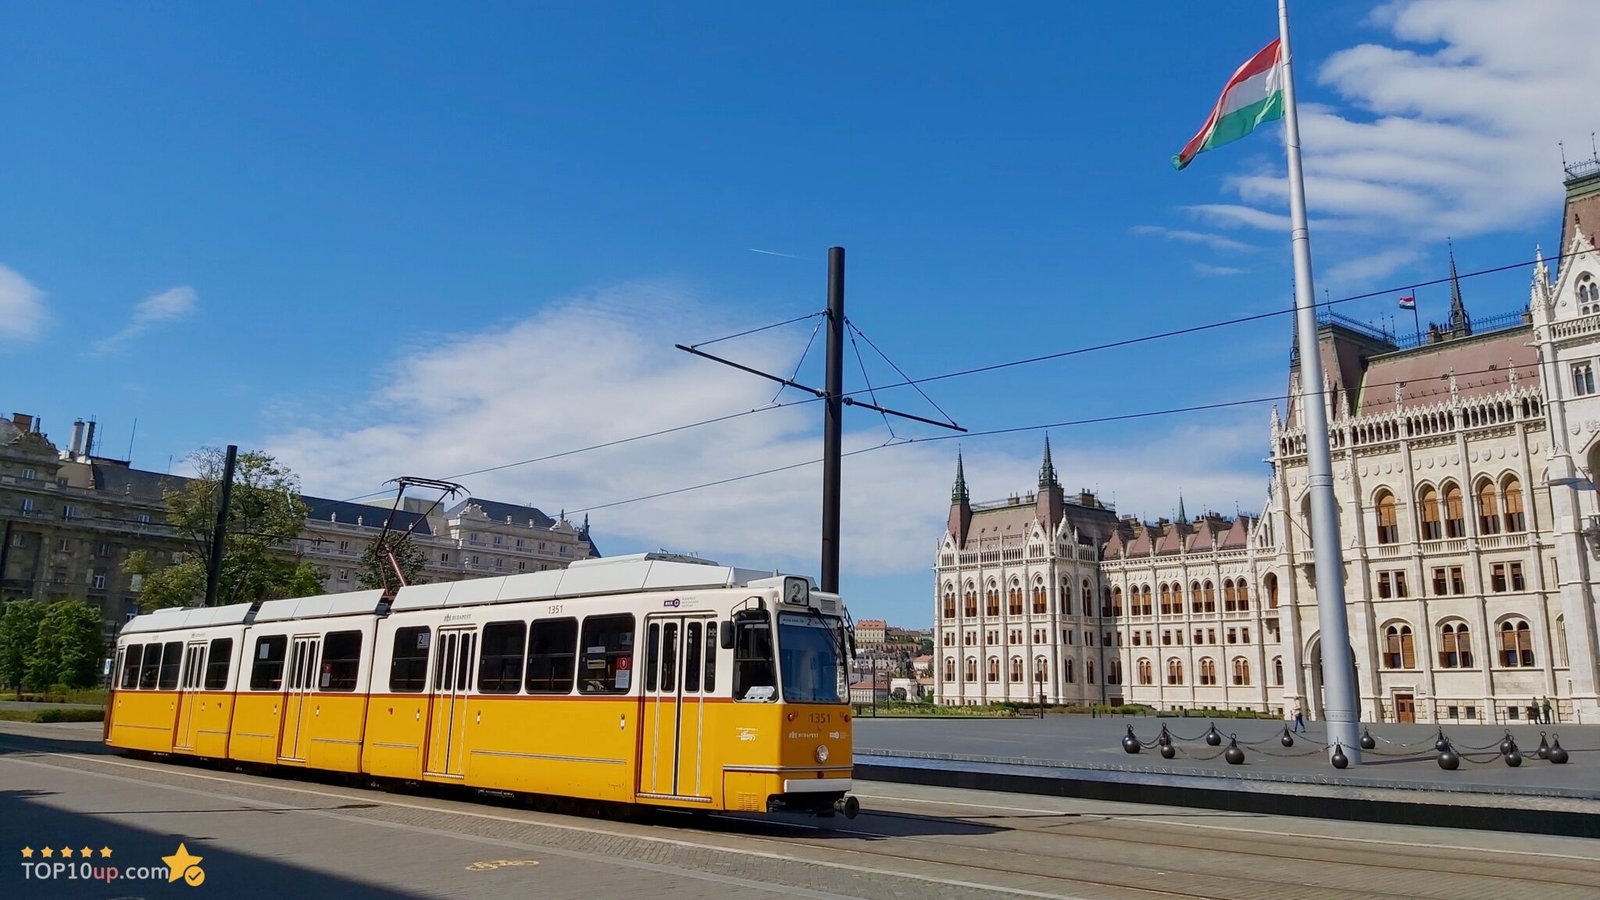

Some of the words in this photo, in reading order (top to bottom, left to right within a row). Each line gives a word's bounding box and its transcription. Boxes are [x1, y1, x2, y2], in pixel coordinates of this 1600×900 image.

[791, 583, 801, 603] 2
[548, 604, 563, 615] 1351
[806, 618, 812, 626] 2
[418, 634, 424, 645] 2
[809, 712, 831, 724] 1351
